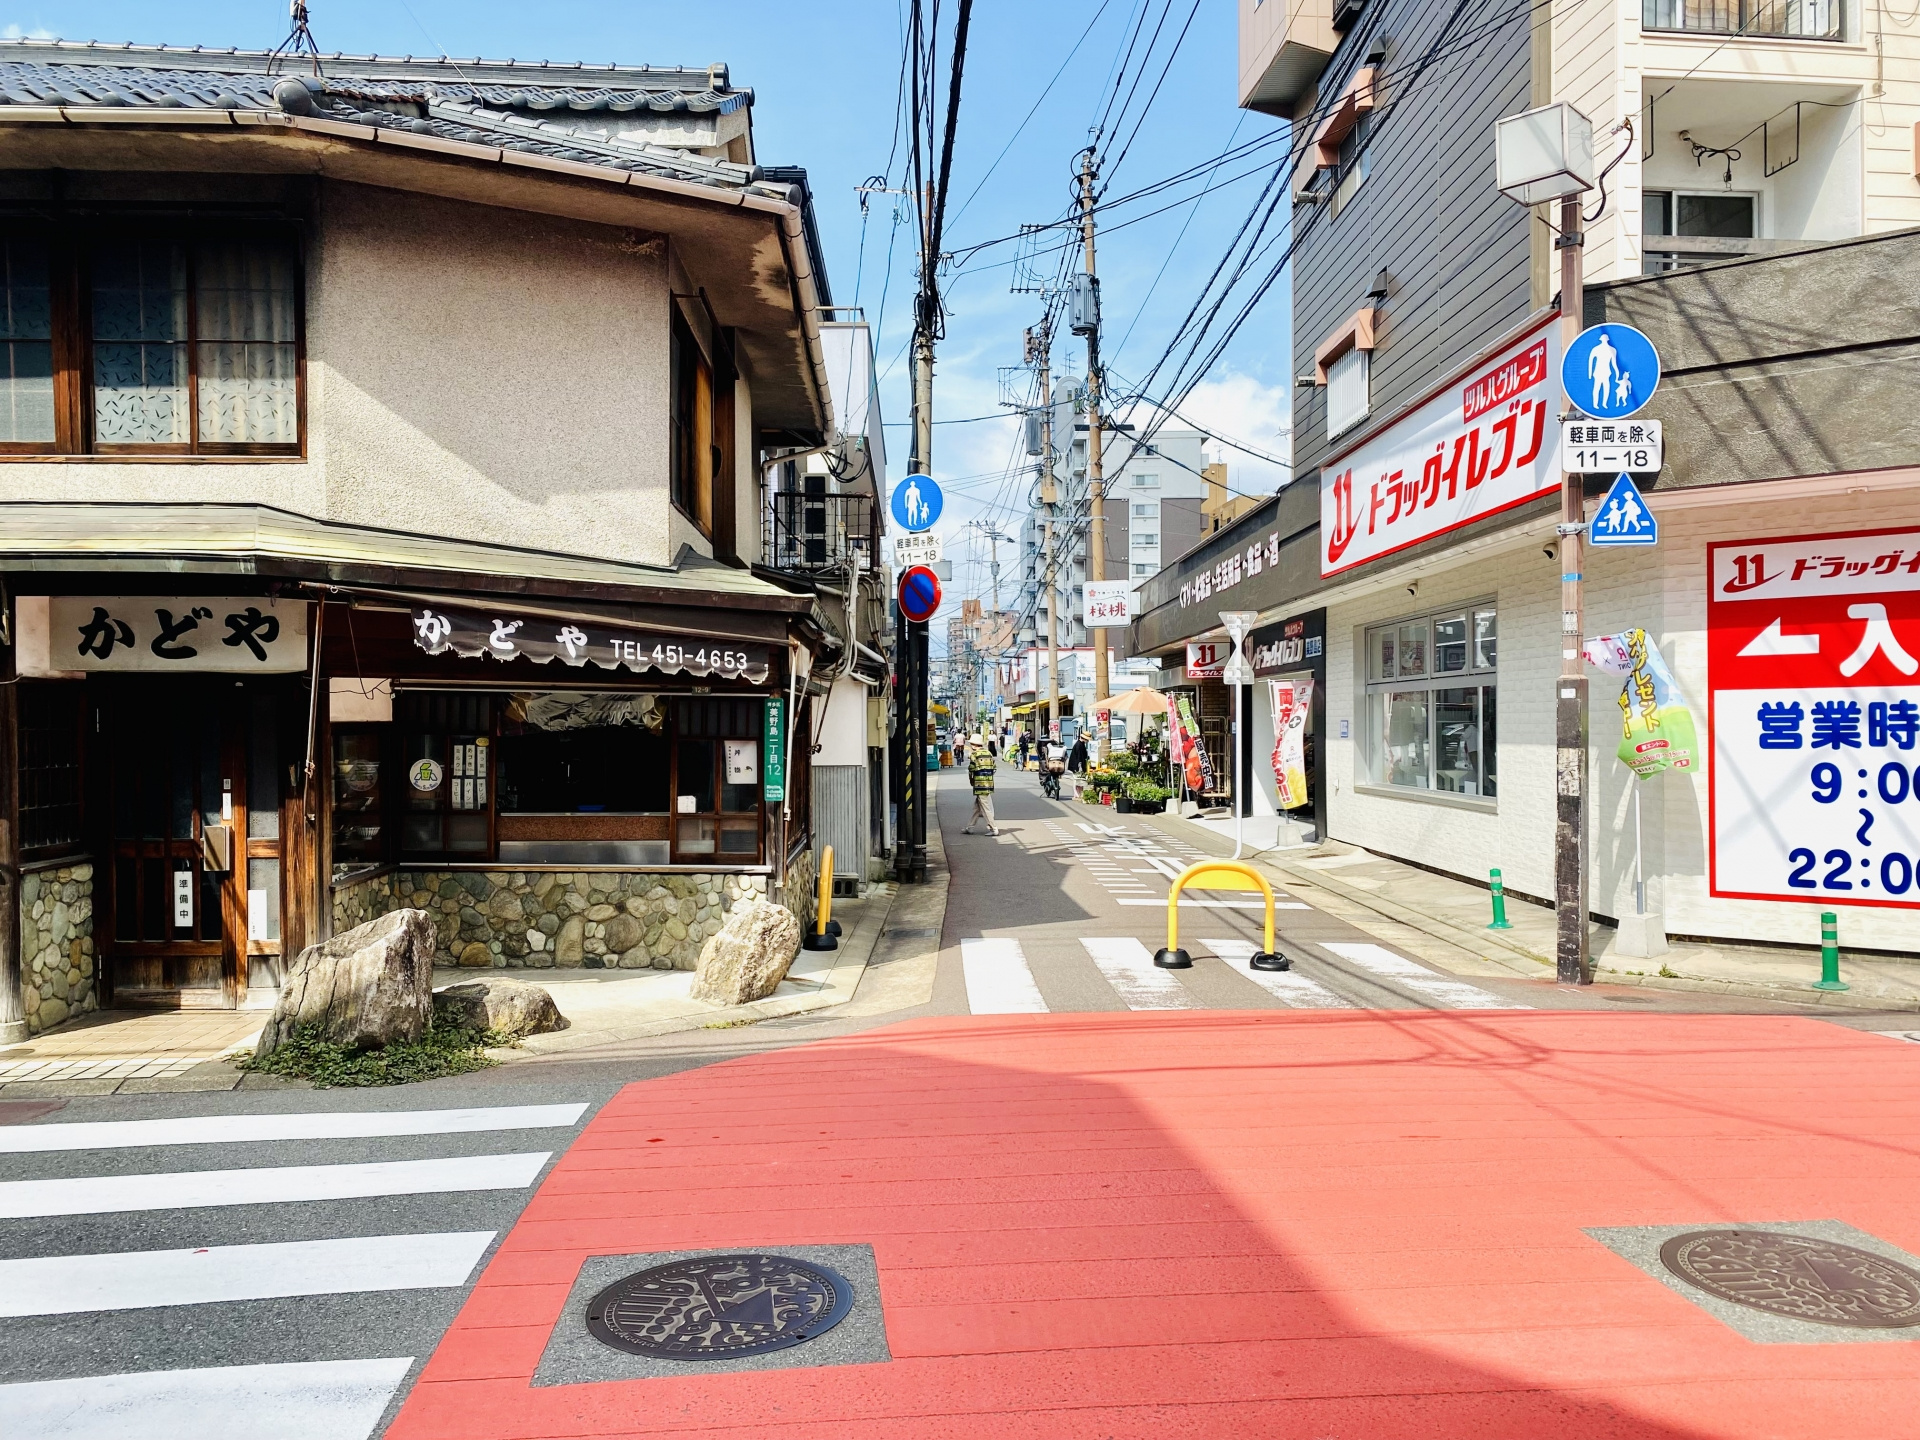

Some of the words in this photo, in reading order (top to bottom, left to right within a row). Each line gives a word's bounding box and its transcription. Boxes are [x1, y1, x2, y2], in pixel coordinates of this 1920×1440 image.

[1465, 347, 1545, 420] ツルハグループ
[1569, 425, 1656, 445] 軽車両を除く
[1369, 399, 1546, 535] ドラッグイレブン
[897, 535, 940, 549] 軽車両を除く
[78, 606, 280, 662] かどや
[415, 610, 588, 659] かどや
[1089, 602, 1127, 619] 桜桃
[1839, 603, 1919, 678] 入
[769, 708, 778, 764] 美野島一丁目
[767, 765, 781, 776] 12
[1810, 761, 1920, 804] 9:0
[1788, 847, 1920, 895] 22:0
[178, 879, 189, 919] 準備中
